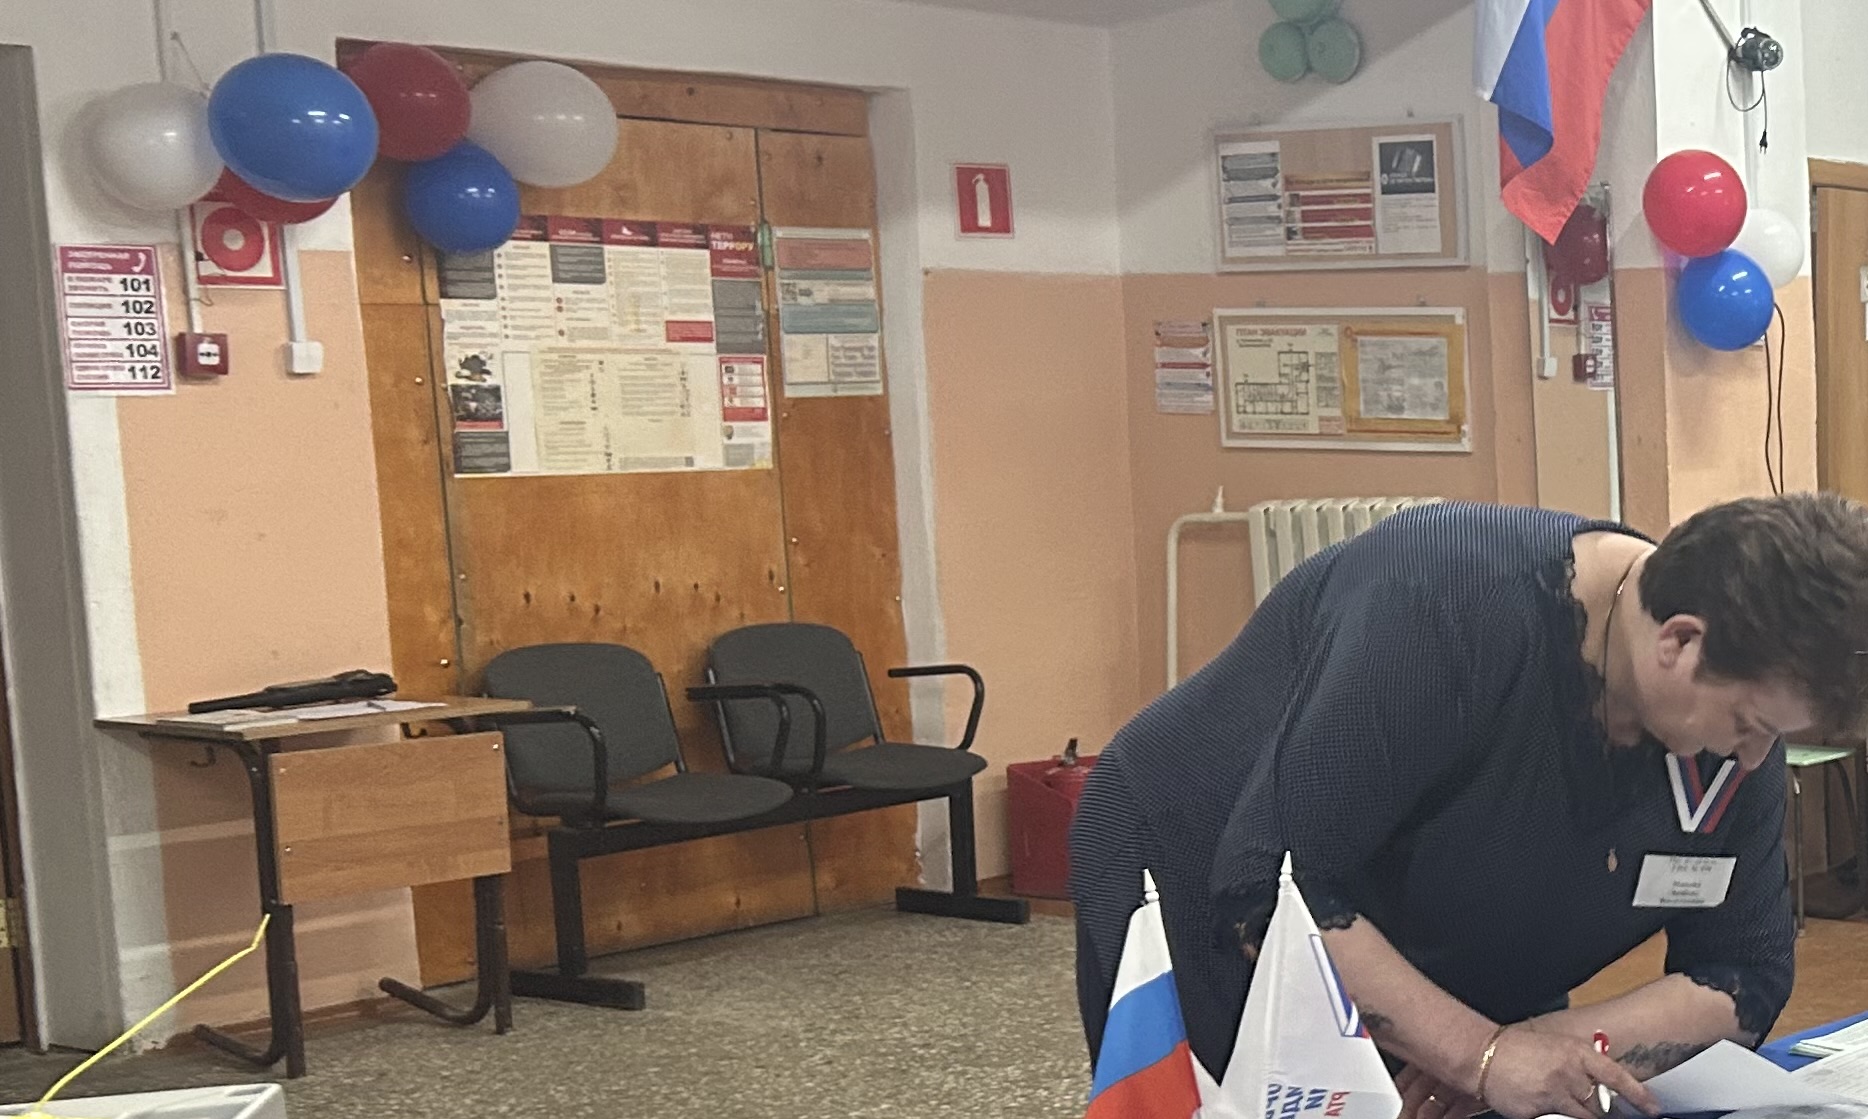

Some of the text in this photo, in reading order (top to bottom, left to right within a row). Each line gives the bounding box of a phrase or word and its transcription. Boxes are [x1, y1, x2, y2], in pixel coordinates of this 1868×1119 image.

[119, 277, 151, 293] 101
[121, 300, 155, 315] 102
[123, 321, 157, 336] 103
[125, 343, 159, 358] 104
[127, 365, 162, 380] 112
